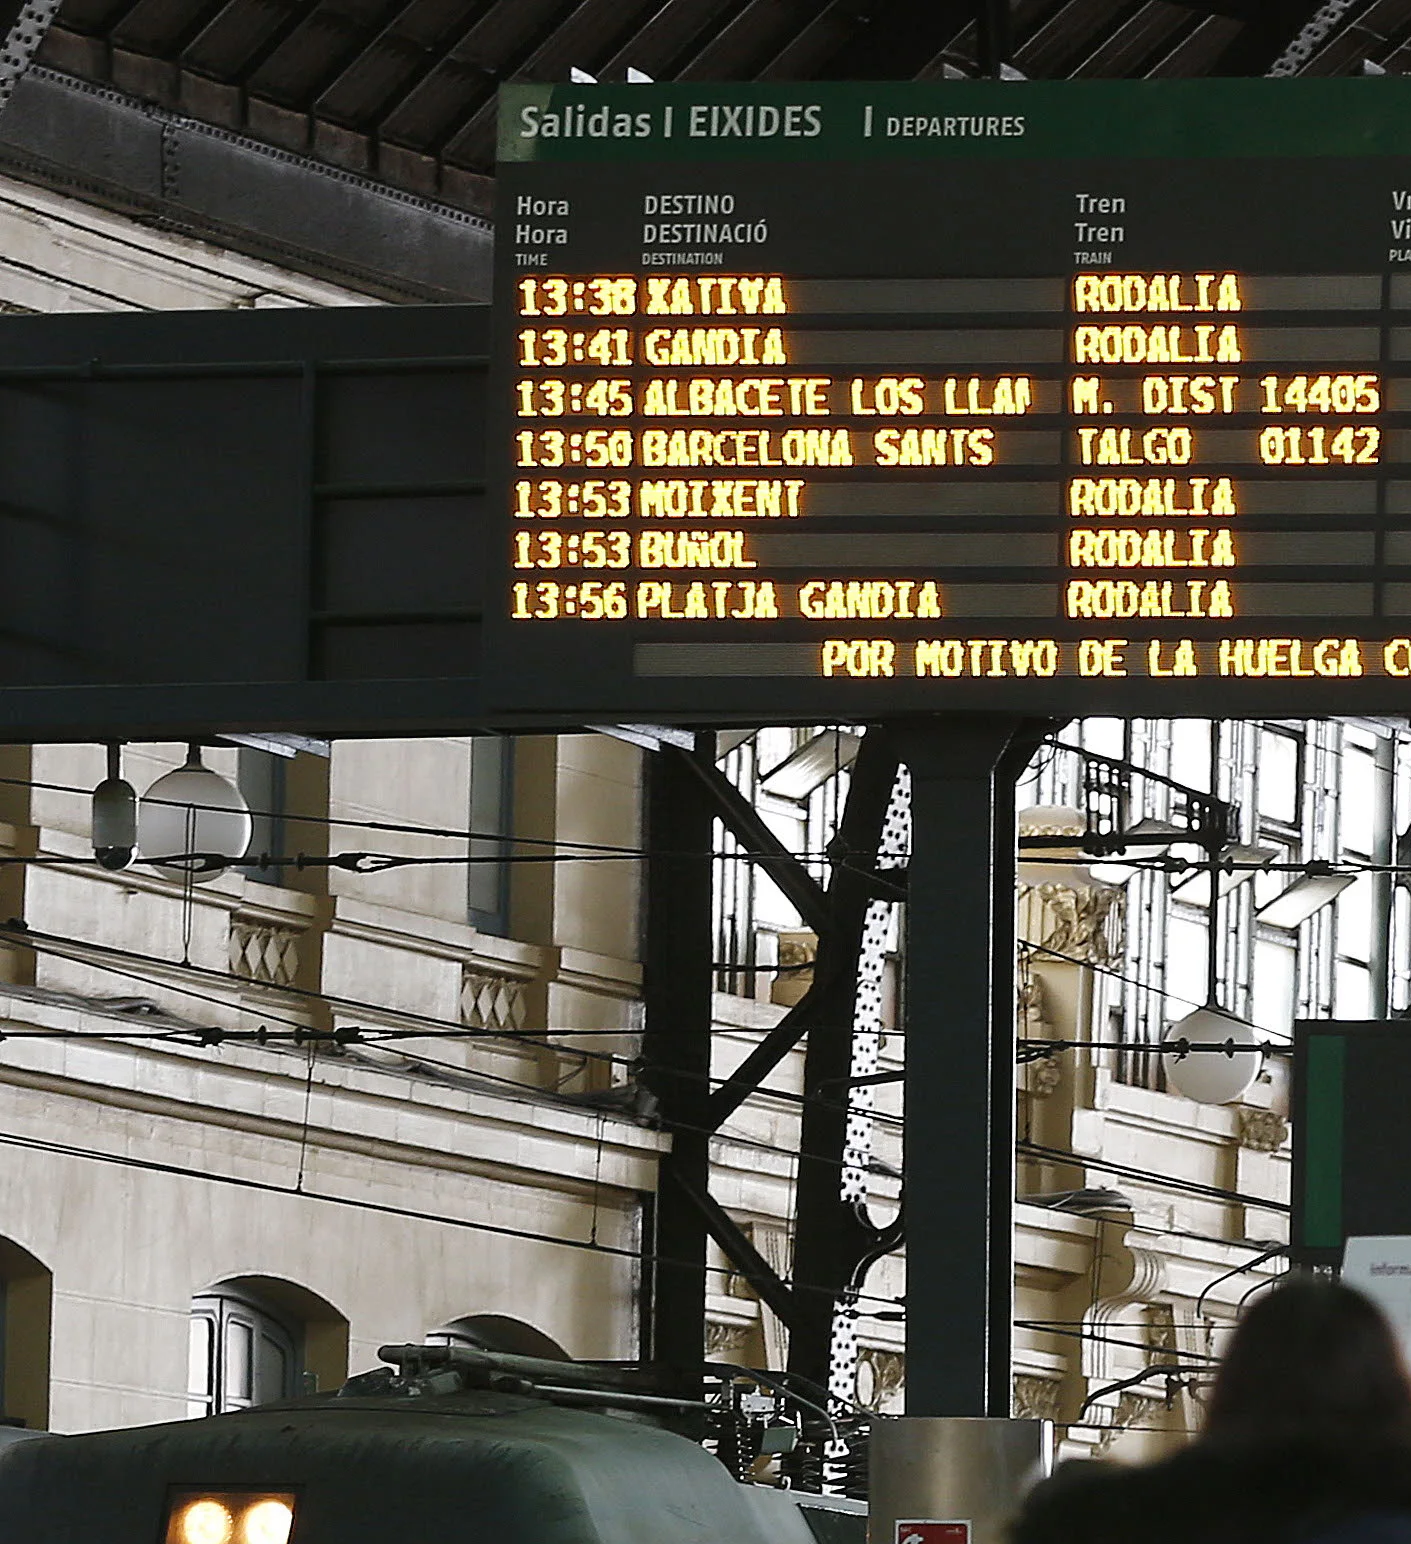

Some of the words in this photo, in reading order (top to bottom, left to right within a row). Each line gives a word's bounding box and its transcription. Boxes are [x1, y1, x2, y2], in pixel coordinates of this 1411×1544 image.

[519, 103, 651, 138] Salidas
[689, 105, 821, 137] EIXIDES
[886, 116, 1025, 137] DEPARTURES
[517, 195, 569, 216] Hora
[644, 194, 735, 215] DESTINO
[1075, 193, 1125, 214] Tren
[515, 224, 568, 244] Hora
[643, 218, 768, 244] DESTINACIÓ
[1074, 222, 1124, 243] Tren
[514, 253, 548, 266] TIME
[641, 252, 723, 266] DESTINATION
[1073, 251, 1112, 265] TRAIN
[647, 277, 786, 315] XATIVA
[1075, 274, 1241, 312] RODALIA
[518, 329, 633, 366] 13:41
[645, 328, 786, 366] GANDIA
[1075, 325, 1241, 363] RODALIA
[516, 379, 633, 417] 13:45
[644, 378, 831, 416] ALBACETE
[851, 378, 924, 415] LOS
[1073, 377, 1113, 414] M.
[1143, 376, 1239, 414] DIST
[1260, 375, 1380, 413] 14405
[516, 430, 634, 467] 13:50
[642, 429, 853, 467] BARCELONA
[874, 428, 994, 466] SANTS
[1078, 427, 1192, 465] TALGO
[1260, 427, 1380, 464] 01142
[514, 481, 631, 518] 13:53
[639, 480, 805, 517] MOIXENT
[1070, 478, 1236, 516] RODALIA
[514, 531, 631, 568] 13:53
[1070, 529, 1235, 567] RODALIA
[512, 582, 627, 619] 13:56
[637, 581, 778, 619] PLATJA
[799, 581, 941, 619] GANDIA
[1067, 580, 1233, 618] RODALIA
[822, 640, 895, 677] POR
[915, 640, 1058, 677] MOTIVO
[1078, 639, 1128, 677] DE
[1148, 639, 1197, 677] LA
[1219, 639, 1363, 677] HUELGA
